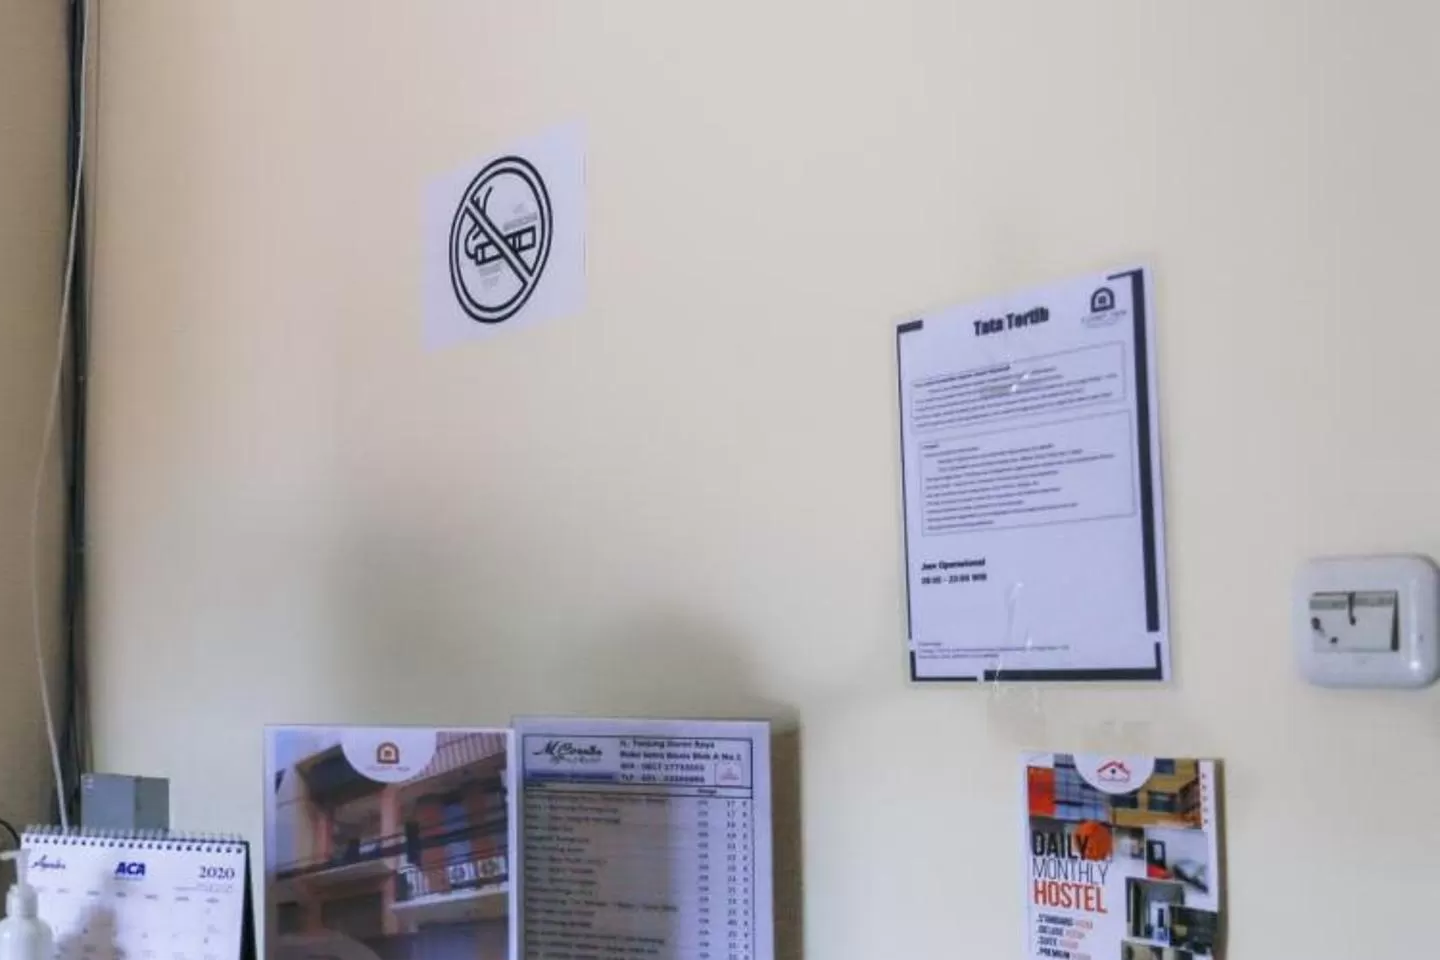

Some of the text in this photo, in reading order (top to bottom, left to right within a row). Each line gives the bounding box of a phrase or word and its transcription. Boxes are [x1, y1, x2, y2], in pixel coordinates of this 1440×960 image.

[973, 306, 1050, 337] Tata Tertib
[1032, 829, 1090, 860] DAILY
[115, 861, 146, 876] ACA
[199, 865, 236, 880] 2020
[1032, 857, 1109, 885] MONTHLY
[1034, 879, 1108, 914] HOSTEL
